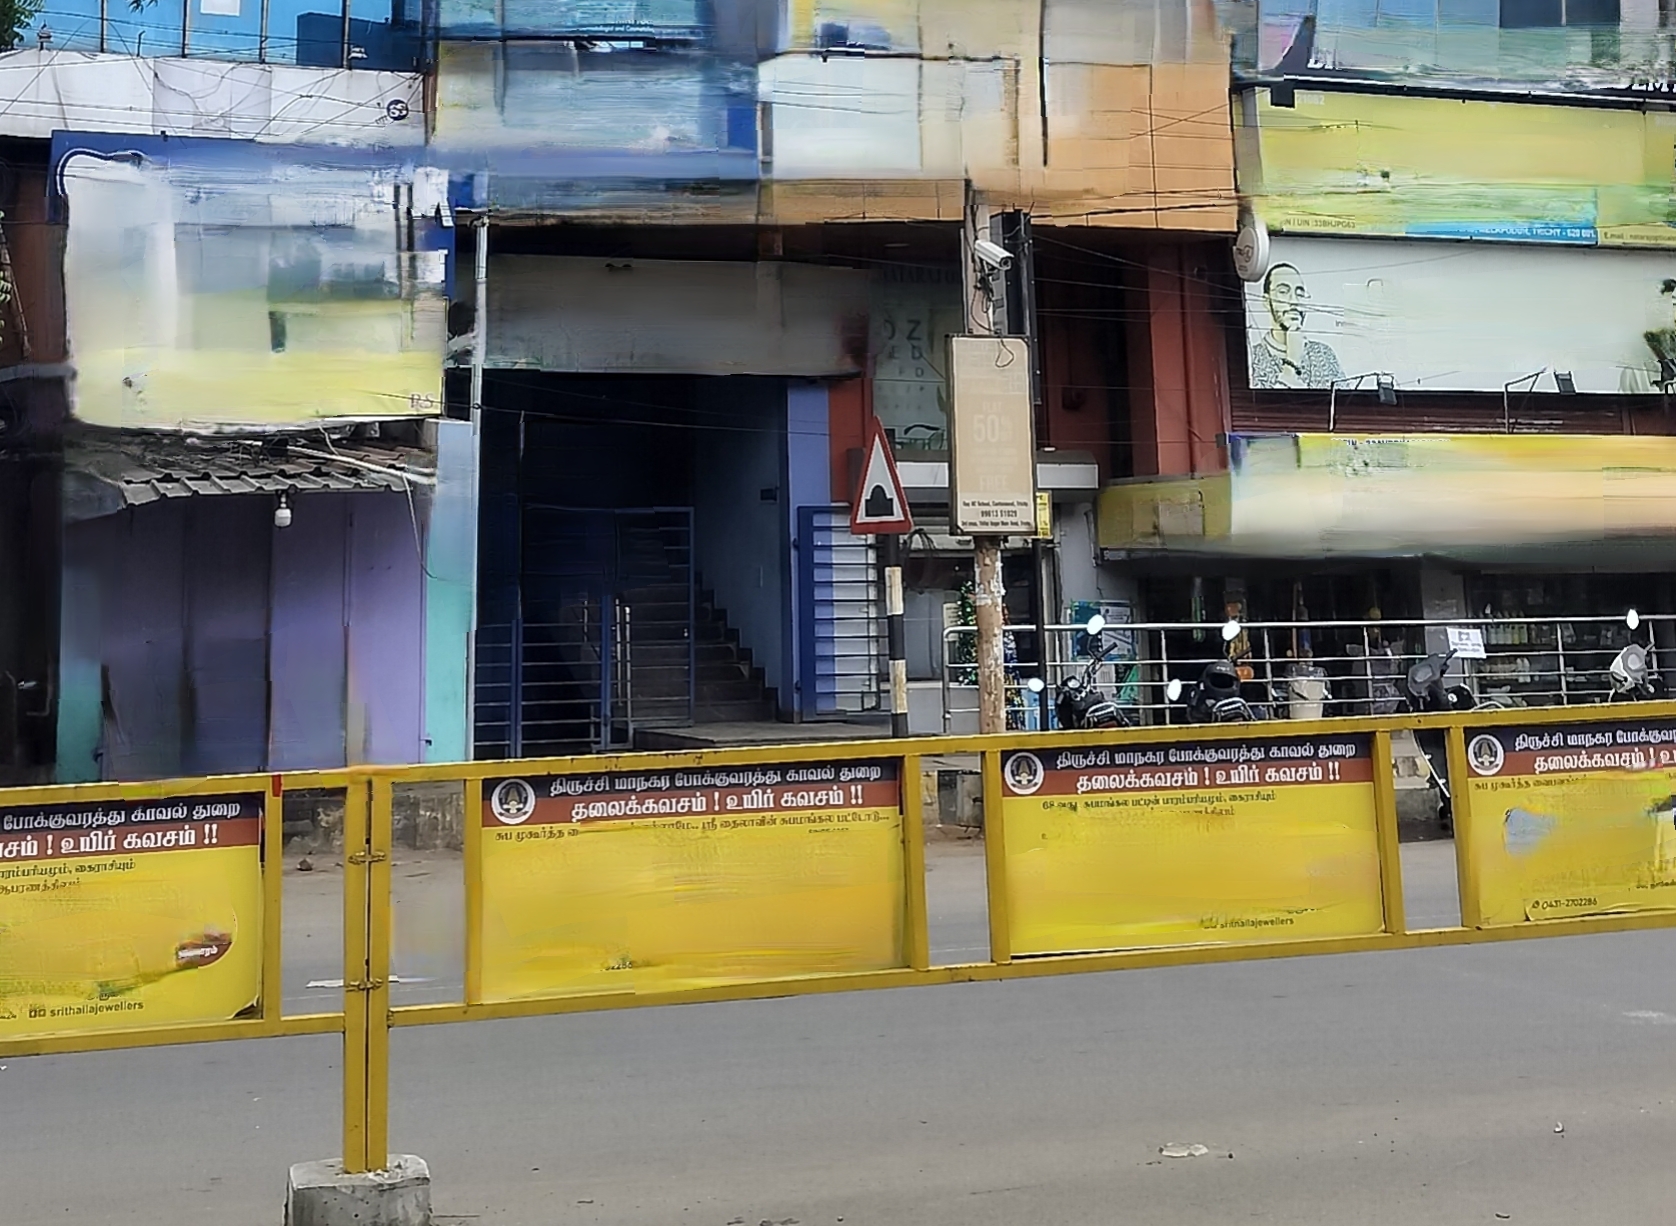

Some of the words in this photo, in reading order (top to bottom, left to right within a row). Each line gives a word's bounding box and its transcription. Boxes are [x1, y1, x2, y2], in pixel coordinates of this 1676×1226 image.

[1056, 750, 1111, 770] திருச்சி
[1115, 750, 1165, 767] மாநகர
[1168, 743, 1265, 764] போக்குவரத்து
[1269, 742, 1314, 759] காவல்
[1317, 742, 1356, 759] துறை
[1515, 731, 1563, 751] திருச்சி
[1567, 731, 1613, 748] மாநகர
[550, 775, 609, 796] திருச்சி
[615, 775, 670, 792] மாநகர
[675, 767, 781, 788] போக்குவரத்து
[786, 764, 835, 782] காவல்
[840, 764, 881, 781] துறை
[1076, 765, 1198, 795] தலைக்கவசம்
[1215, 763, 1260, 784] உயிர்
[1264, 761, 1323, 783] கவசம்
[3, 807, 126, 831] போக்குவரத்து
[131, 802, 187, 822] காவல்
[193, 801, 241, 820] துறை
[571, 791, 706, 822] தலைக்கவசம்
[726, 788, 774, 810] உயிர்
[780, 785, 844, 808] கவசம்
[61, 829, 116, 854] உயிர்
[123, 824, 196, 849] கவசம்
